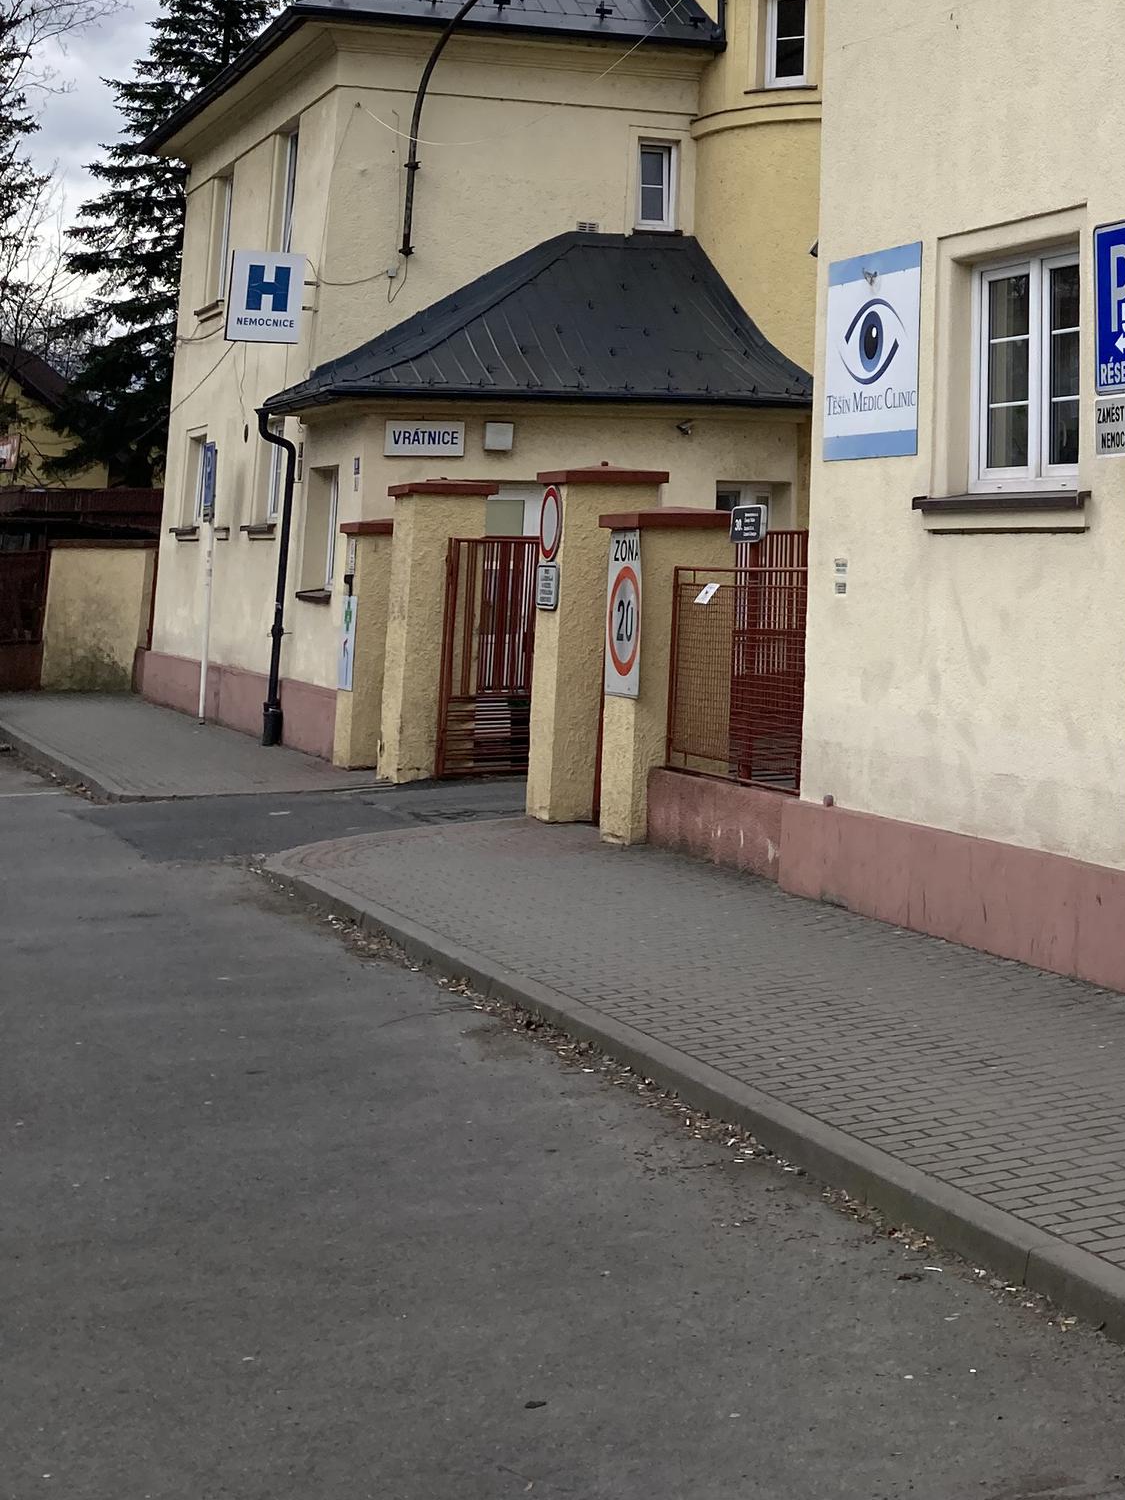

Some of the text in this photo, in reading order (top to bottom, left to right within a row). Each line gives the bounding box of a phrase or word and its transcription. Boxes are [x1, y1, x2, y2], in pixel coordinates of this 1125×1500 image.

[245, 264, 291, 312] H
[236, 317, 295, 328] NEMOCNICE
[393, 428, 459, 445] VRÁTNICE
[616, 599, 633, 642] 20
